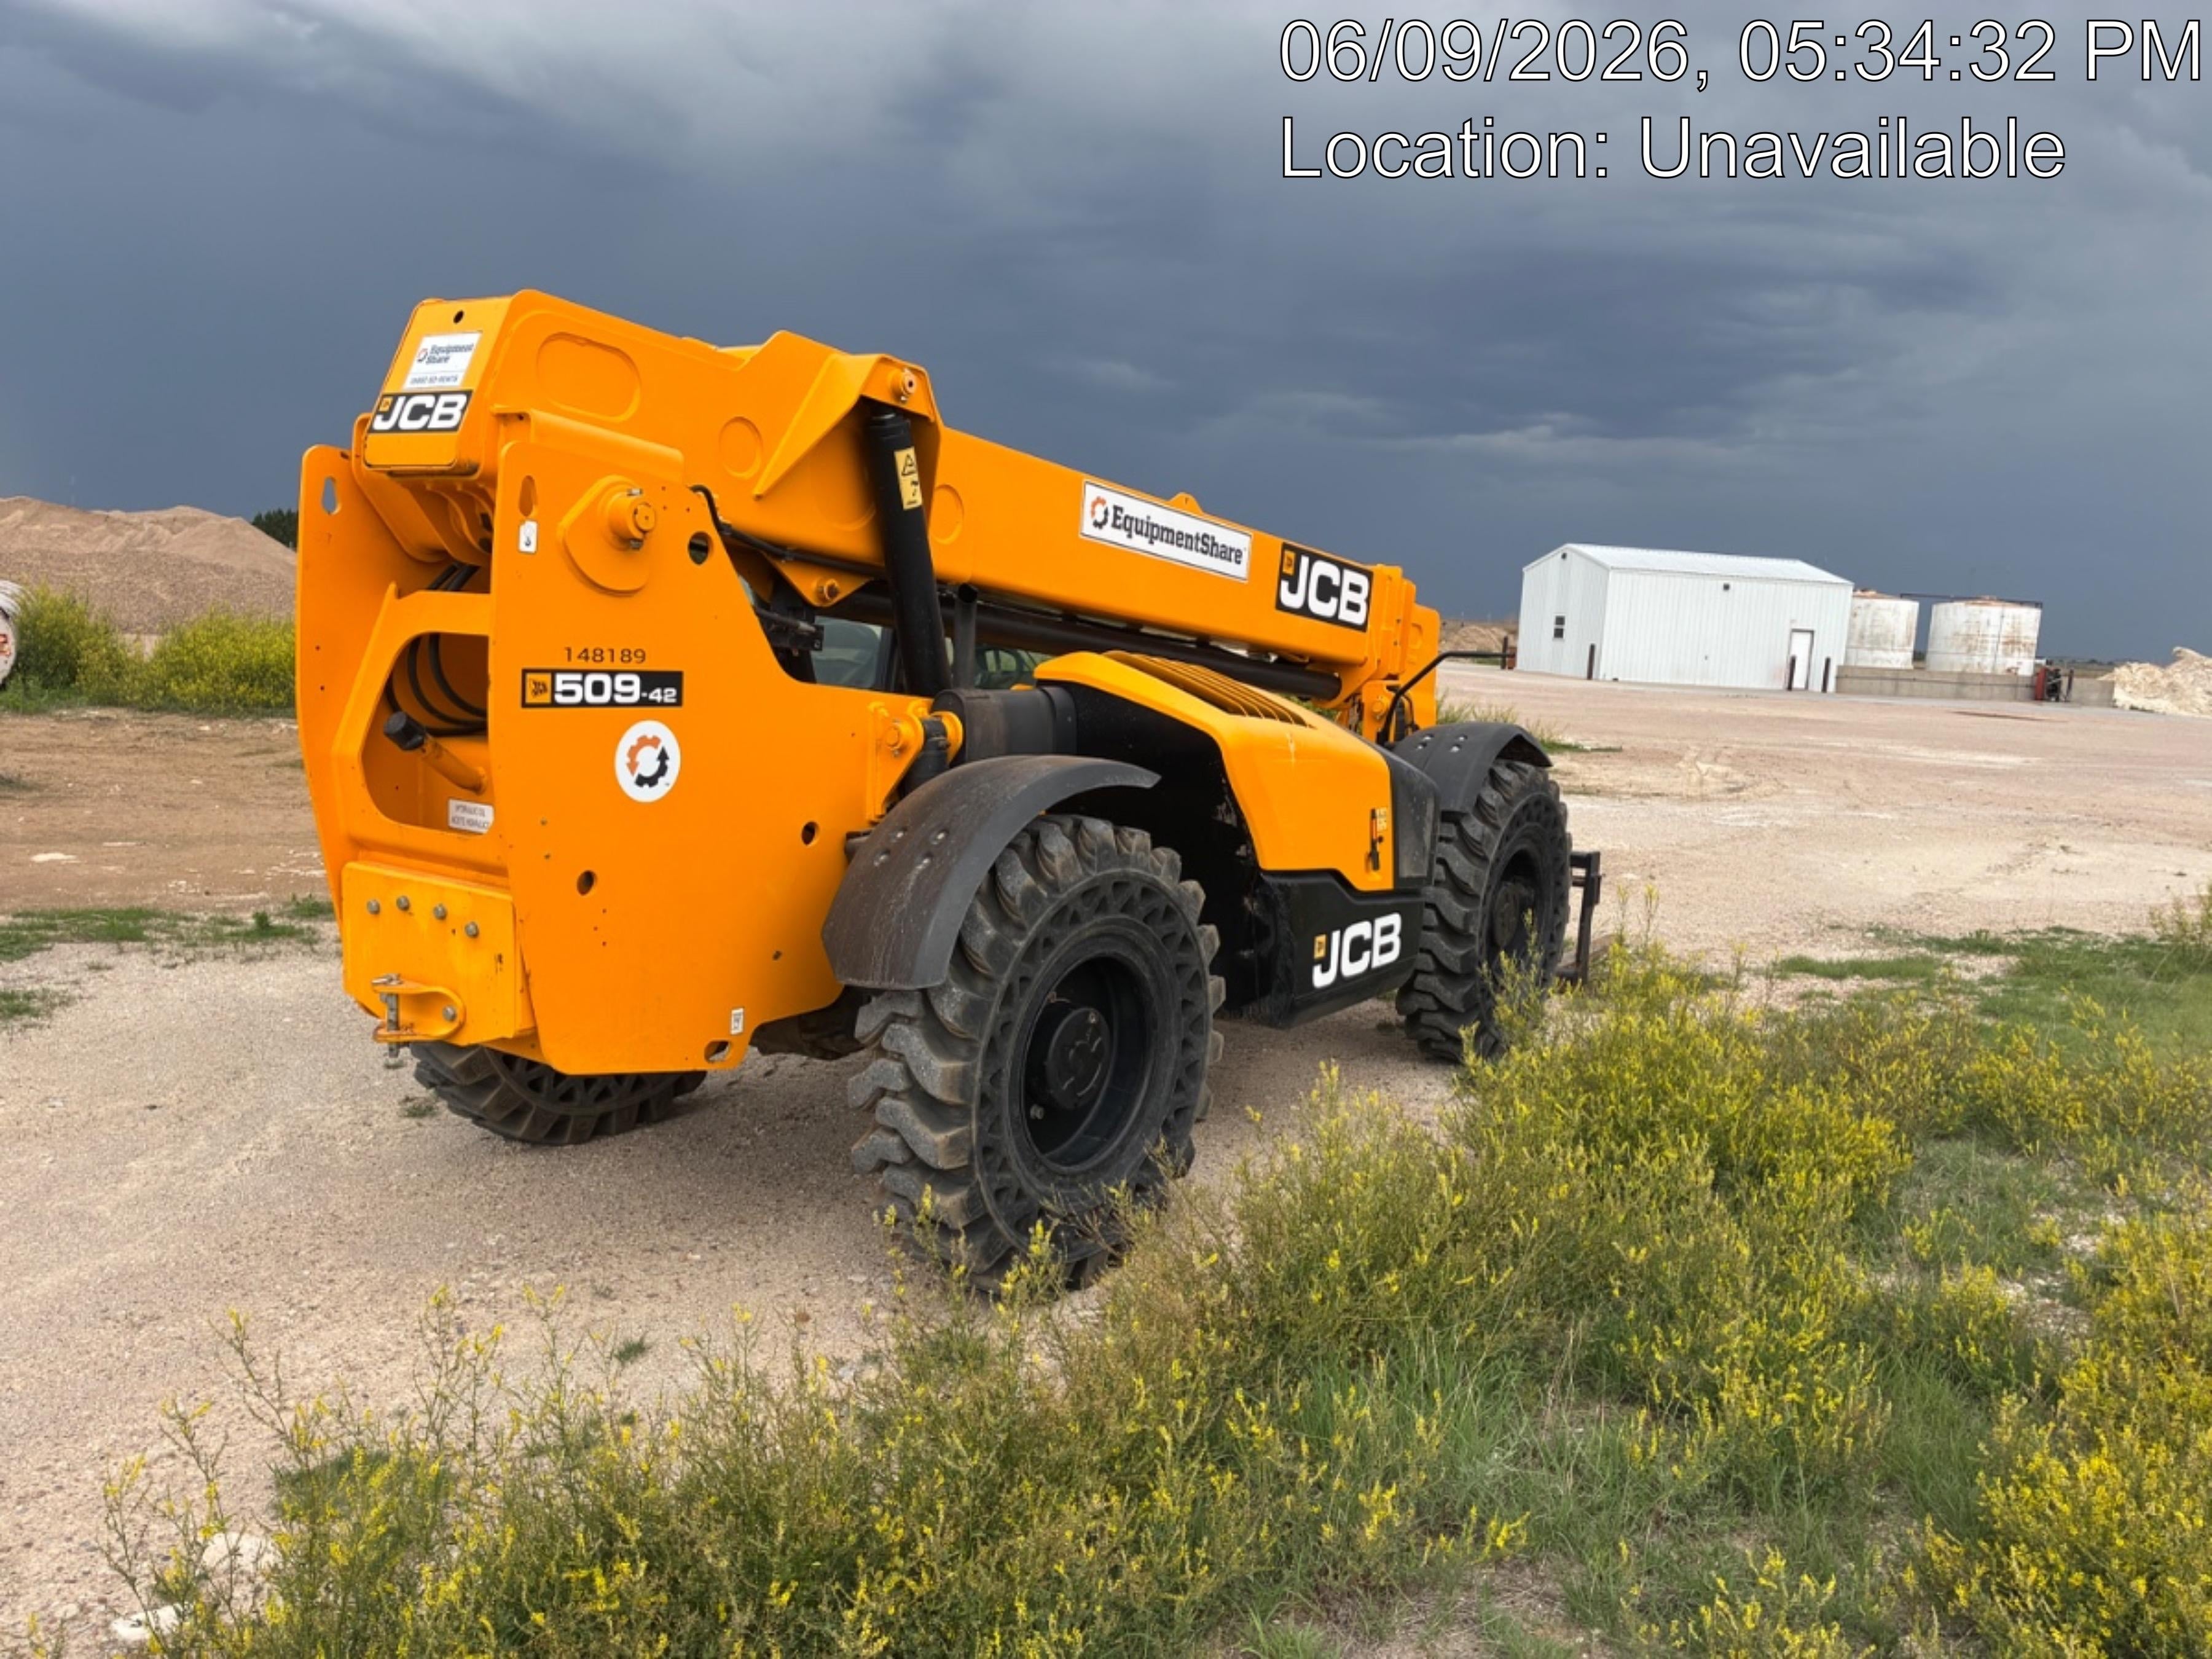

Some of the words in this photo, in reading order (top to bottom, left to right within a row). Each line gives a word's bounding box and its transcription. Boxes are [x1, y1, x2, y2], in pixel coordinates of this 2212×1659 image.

[372, 394, 467, 430] JCB
[1111, 504, 1243, 565] EquipmentShare
[1280, 554, 1370, 626] JCB
[564, 646, 646, 664] 148189
[1312, 912, 1402, 989] JCB
